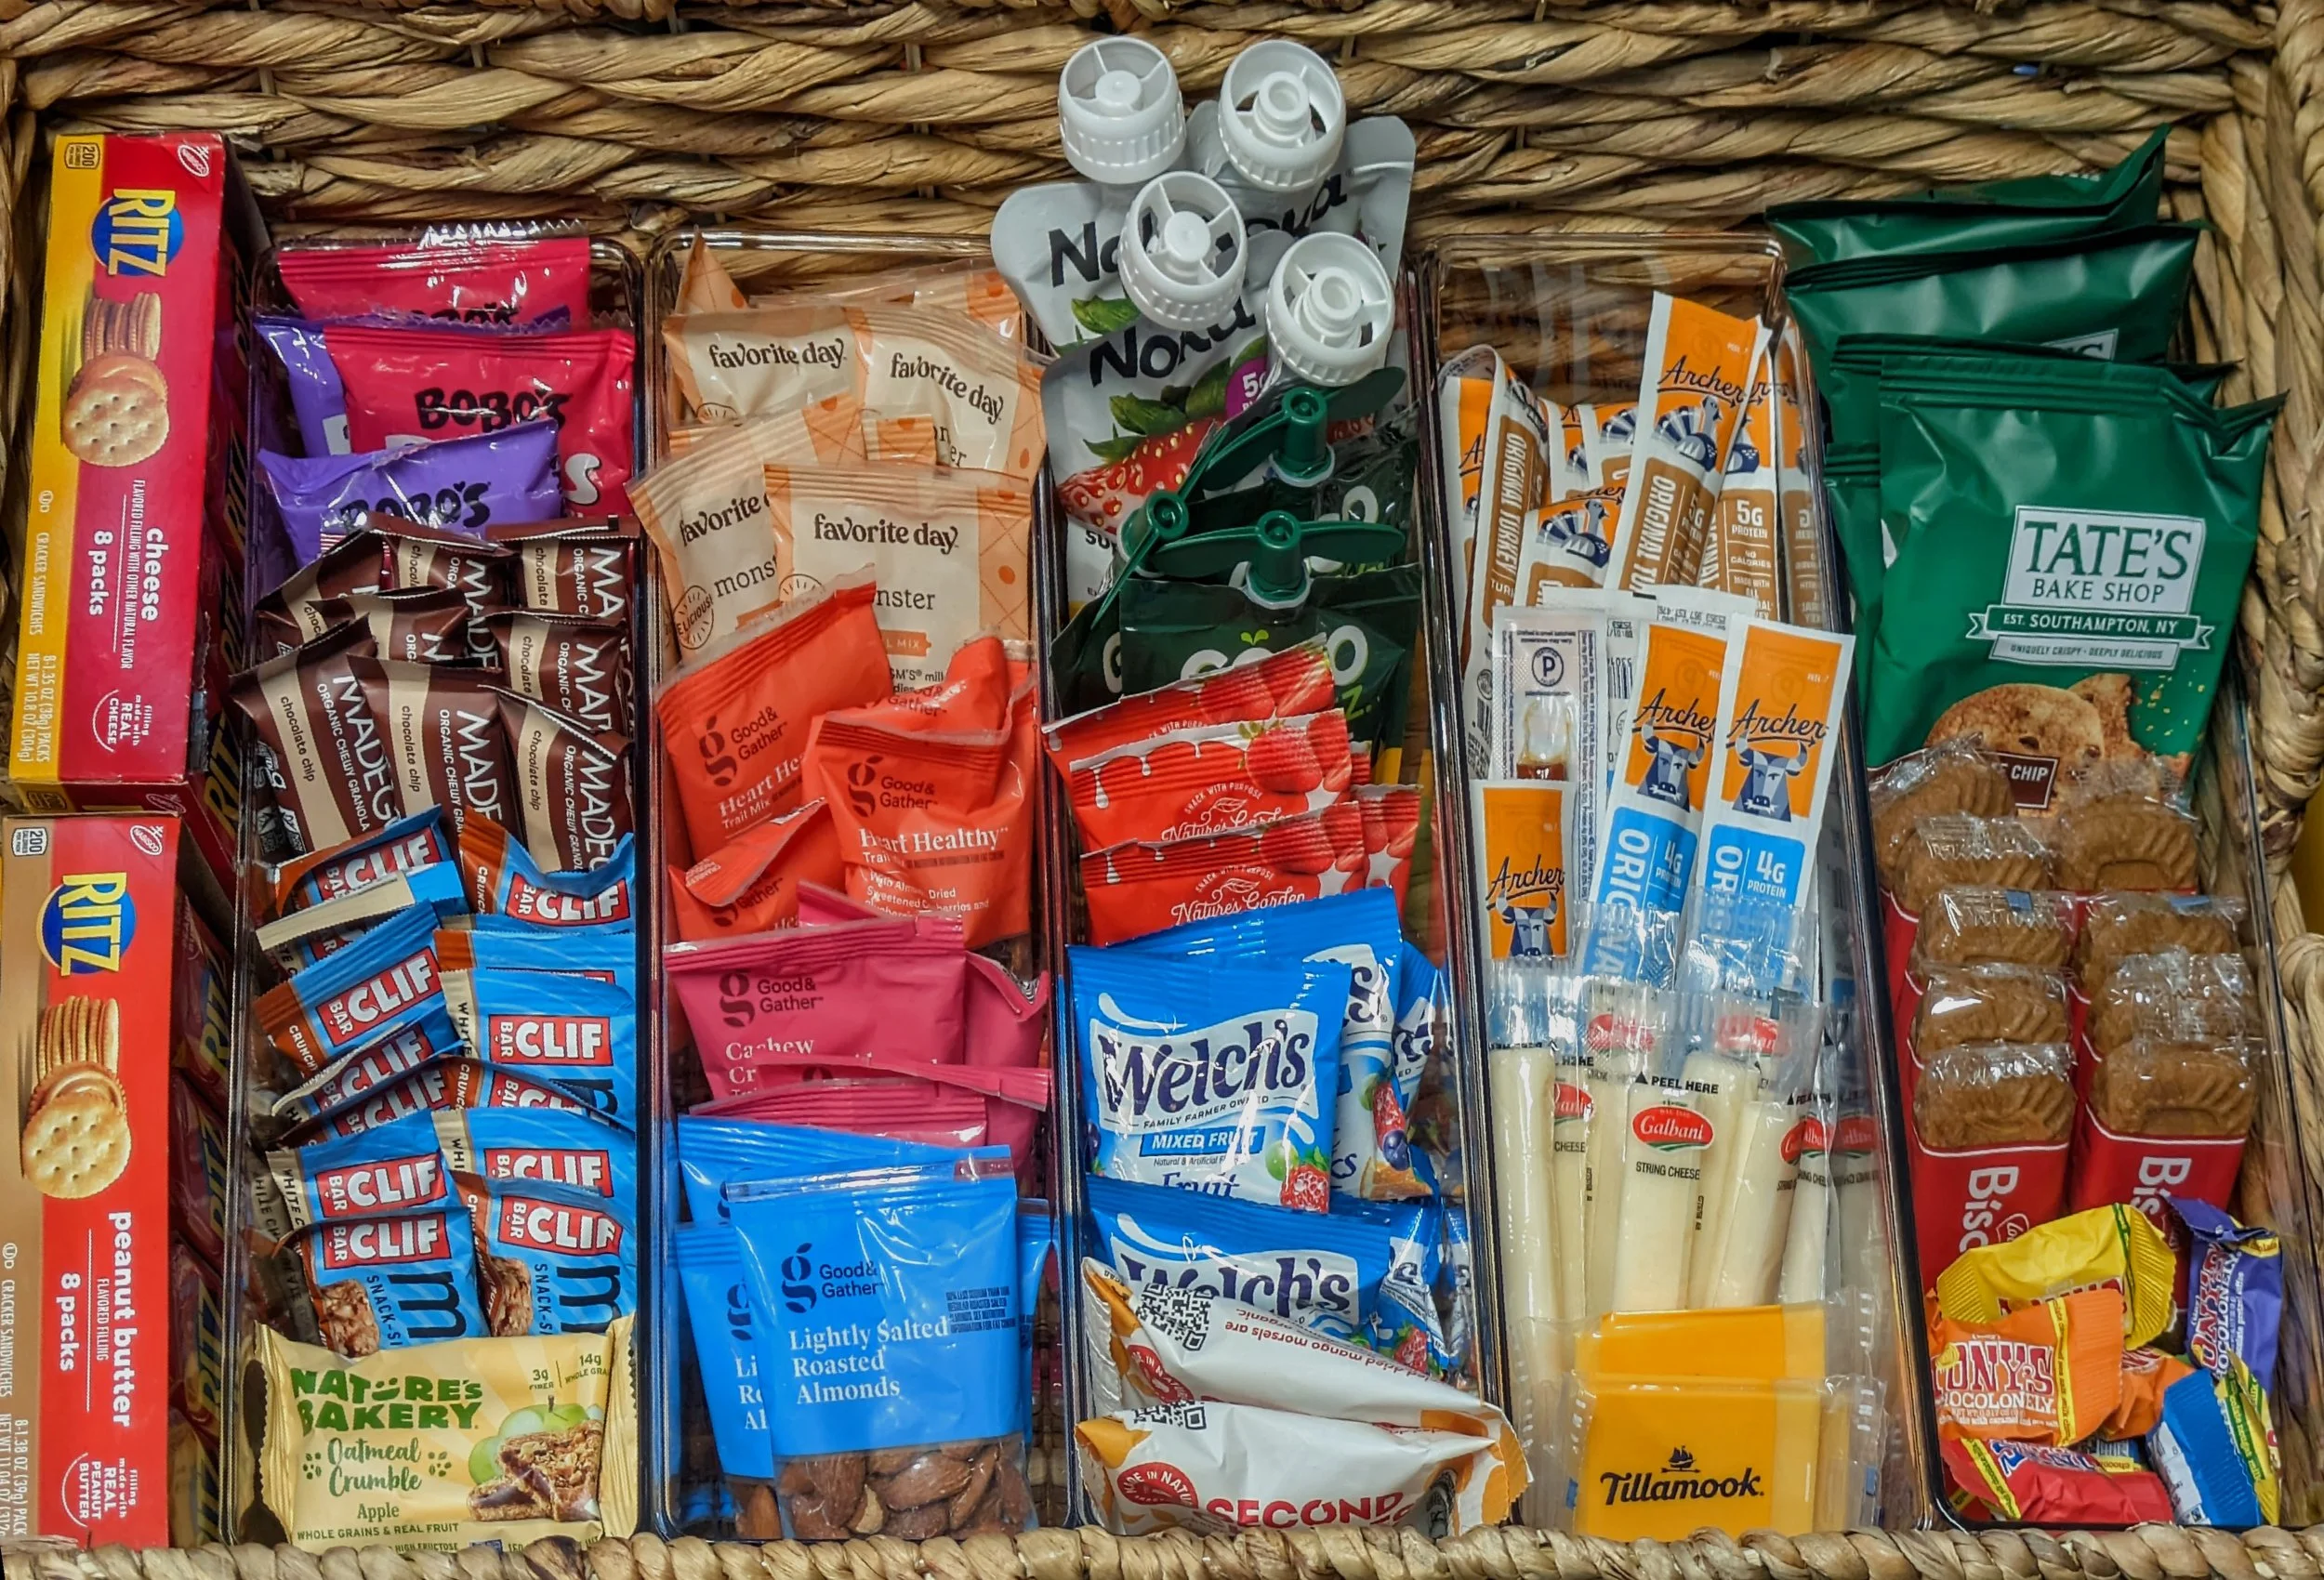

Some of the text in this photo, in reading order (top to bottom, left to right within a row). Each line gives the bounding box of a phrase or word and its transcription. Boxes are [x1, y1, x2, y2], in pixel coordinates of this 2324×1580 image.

[108, 189, 175, 277] RITZ
[709, 338, 845, 370] favorite day
[891, 352, 1004, 426] favorite day
[1657, 354, 1748, 400] Archer
[679, 493, 763, 547] favorite
[1495, 432, 1527, 577] ORIGINAL TURKEY
[1636, 475, 1677, 561] ORIGINAL
[1736, 499, 1763, 527] 5G
[814, 513, 958, 555] favorite day
[1731, 524, 1768, 539] PROTEIN
[2023, 519, 2194, 581] TATE'S
[88, 530, 113, 615] 8 packs
[121, 480, 145, 669] FLAVORED FILLING OTHER NATURAL FLAVOR
[141, 527, 169, 621] cheese
[535, 546, 548, 606] chocolate
[573, 547, 588, 601] ORGANIC
[1730, 556, 1771, 569] CALORIES
[2031, 579, 2166, 606] BAKE SHOP
[2002, 612, 2180, 635] EST. SOUTHAMPTON, NY
[521, 635, 533, 694] chocolate
[897, 639, 920, 650] MIX
[2052, 645, 2082, 657] CRISPY
[557, 641, 571, 695] ORGANIC
[22, 652, 40, 727] NET WT OZ
[36, 688, 54, 762] OZ PACKS
[107, 698, 119, 744] CHEESE
[120, 703, 133, 740] REAL
[141, 704, 152, 736] filling
[281, 695, 316, 783] chocolate chip
[1727, 699, 1829, 742] Archer
[317, 682, 372, 833] ORGANIC CHEWY GRANOLA
[402, 704, 421, 794] chocolate chip
[439, 708, 462, 806] ORGANIC CHEWY
[737, 721, 789, 762] Gather
[528, 730, 542, 811] chocolate chip
[564, 744, 578, 836] ORGANIC CHEWY
[2011, 764, 2049, 783] CHIP
[718, 779, 773, 819] Heart
[721, 797, 771, 829] Trail Mix
[880, 790, 937, 810] Gather
[1184, 791, 1207, 815] SNACK
[1207, 782, 1227, 796] WITH
[30, 830, 44, 853] 200
[1663, 839, 1684, 875] 4G
[1487, 853, 1565, 898] Archer
[1756, 850, 1786, 884] 4G
[519, 884, 537, 915] BAR
[929, 887, 957, 900] Dried
[1747, 879, 1787, 900] PROTEIN
[58, 872, 127, 977] RITZ
[328, 955, 433, 1035] BAR CLIF
[759, 995, 822, 1015] Gather
[499, 1020, 602, 1060] BAR CLIF
[341, 1030, 425, 1099] CLIF
[1097, 1019, 1311, 1116] Welch's
[1652, 1075, 1720, 1095] PEEL HERE
[1143, 1103, 1227, 1130] FAMILY FARMER
[1640, 1114, 1704, 1140] Galbani
[1152, 1132, 1206, 1151] MIXED
[1154, 1155, 1219, 1167] Natural Artificial
[1555, 1140, 1586, 1153] CHEESE
[328, 1160, 437, 1211] BAR CLIF
[1635, 1161, 1700, 1181] STRING CHEESE
[283, 1167, 302, 1218] WHITE
[332, 1218, 439, 1261] BAR CLIF
[509, 1202, 616, 1250] BAR CLIF
[1, 1279, 15, 1326] CRACKER
[822, 1282, 879, 1299] Gather
[56, 1272, 81, 1372] 8 packs
[97, 1277, 110, 1362] FLAVORED FILLING
[109, 1211, 138, 1428] peanut butter
[788, 1315, 950, 1355] Lightly Salted
[579, 1353, 602, 1367] 14g
[1224, 1320, 1364, 1362] mango morsels are
[532, 1368, 549, 1382] 3g
[564, 1368, 589, 1385] WHOLE
[792, 1348, 885, 1378] Roasted
[797, 1376, 901, 1405] Almonds
[297, 1401, 480, 1436] BAKERY
[14, 1456, 28, 1471] OZ
[327, 1436, 421, 1466] Oatmeal
[78, 1462, 89, 1520] BUTTER
[91, 1461, 102, 1520] PEANUT
[103, 1467, 116, 1511] REAL
[119, 1457, 127, 1519] made with
[127, 1468, 139, 1506] filling
[327, 1463, 422, 1498] Crumble
[1123, 1470, 1159, 1495] MADE IN
[1600, 1467, 1761, 1507] Tillamook
[297, 1521, 460, 1542] WHOLE GRAINS & REAL FRUIT
[357, 1502, 402, 1523] Apple
